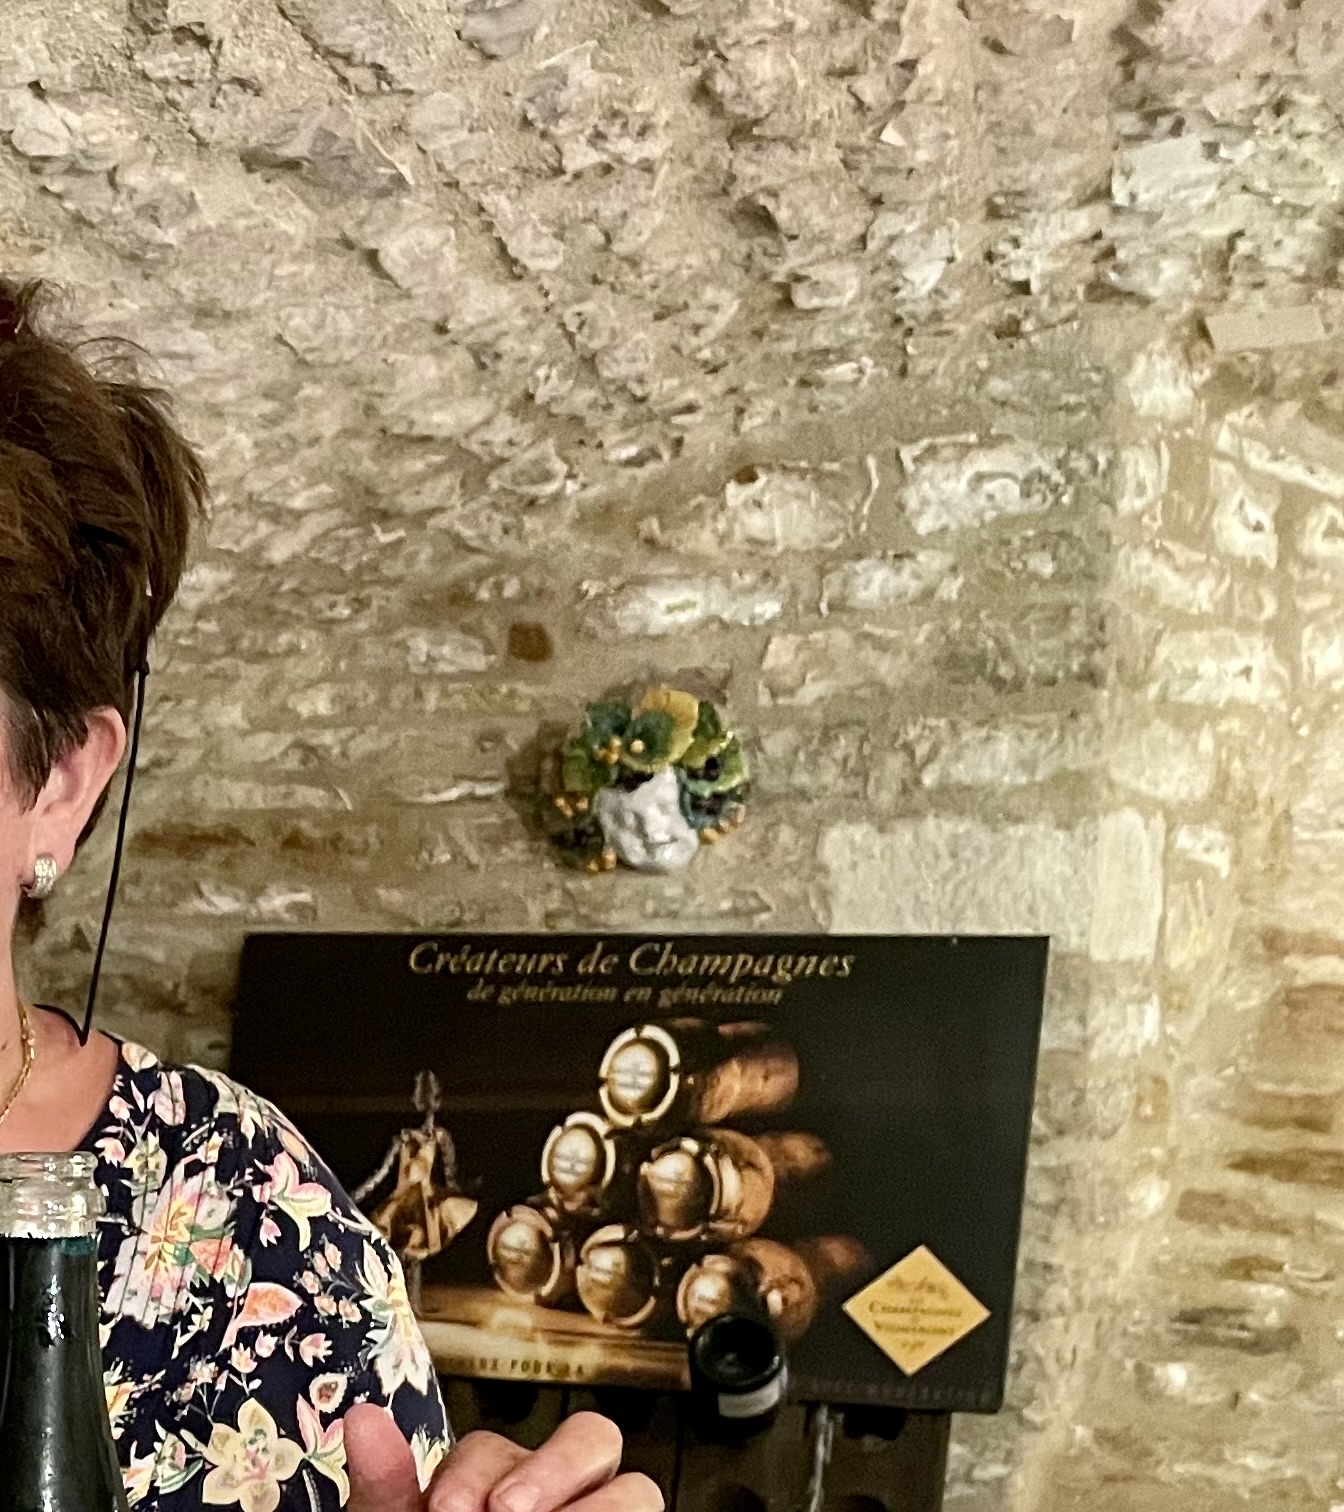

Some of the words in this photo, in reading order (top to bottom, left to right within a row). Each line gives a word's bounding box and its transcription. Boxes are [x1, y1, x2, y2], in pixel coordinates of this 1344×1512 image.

[409, 942, 565, 975] Créateurs
[577, 942, 619, 975] de
[629, 941, 856, 984] Champagnes
[466, 979, 492, 1002] de
